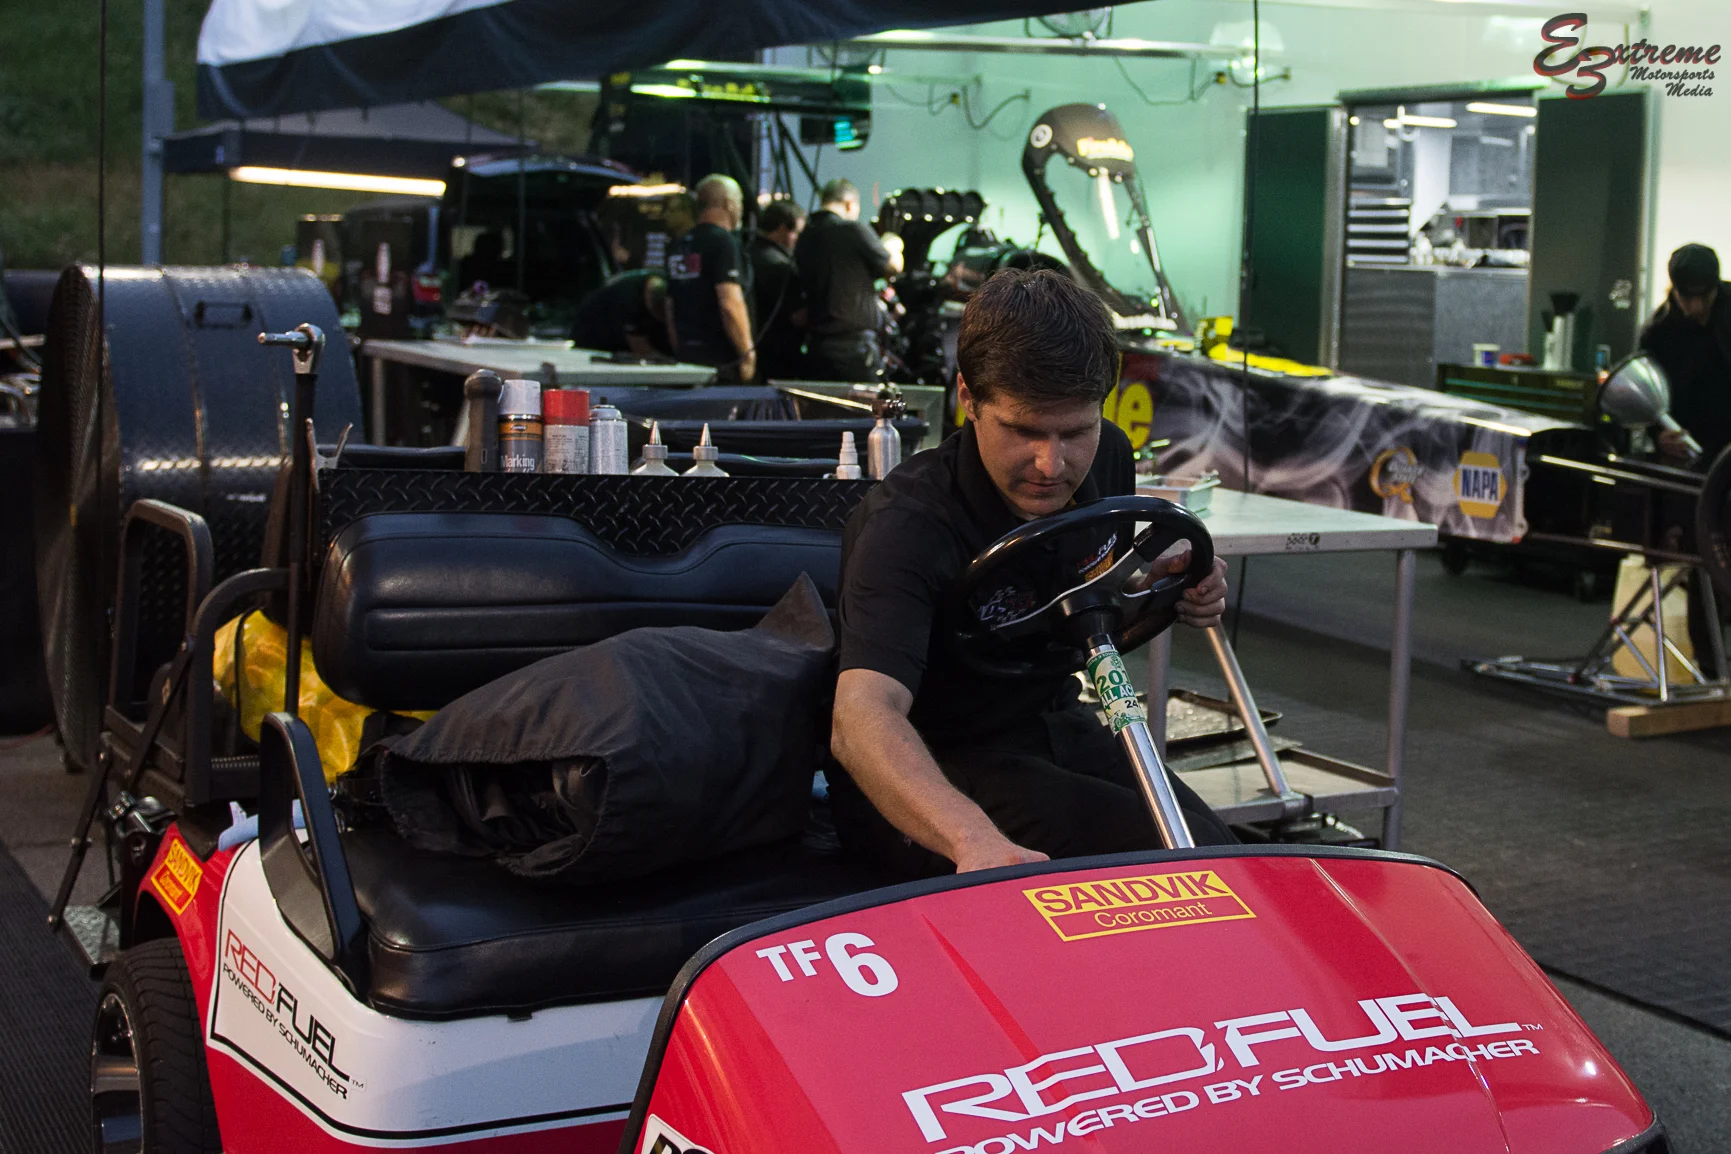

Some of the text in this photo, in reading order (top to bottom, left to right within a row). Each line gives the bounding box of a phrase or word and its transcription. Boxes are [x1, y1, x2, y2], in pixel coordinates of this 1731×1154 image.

[500, 453, 535, 471] Marking
[1461, 467, 1499, 501] NAPA
[1100, 683, 1136, 706] ALL AC
[1034, 873, 1229, 913] SANDVIK
[1094, 901, 1213, 928] Coromant
[223, 963, 348, 1100] POWERED BY SCHUMACHER
[1203, 1074, 1264, 1105] BY
[1272, 1038, 1541, 1092] SCHUMACHER
